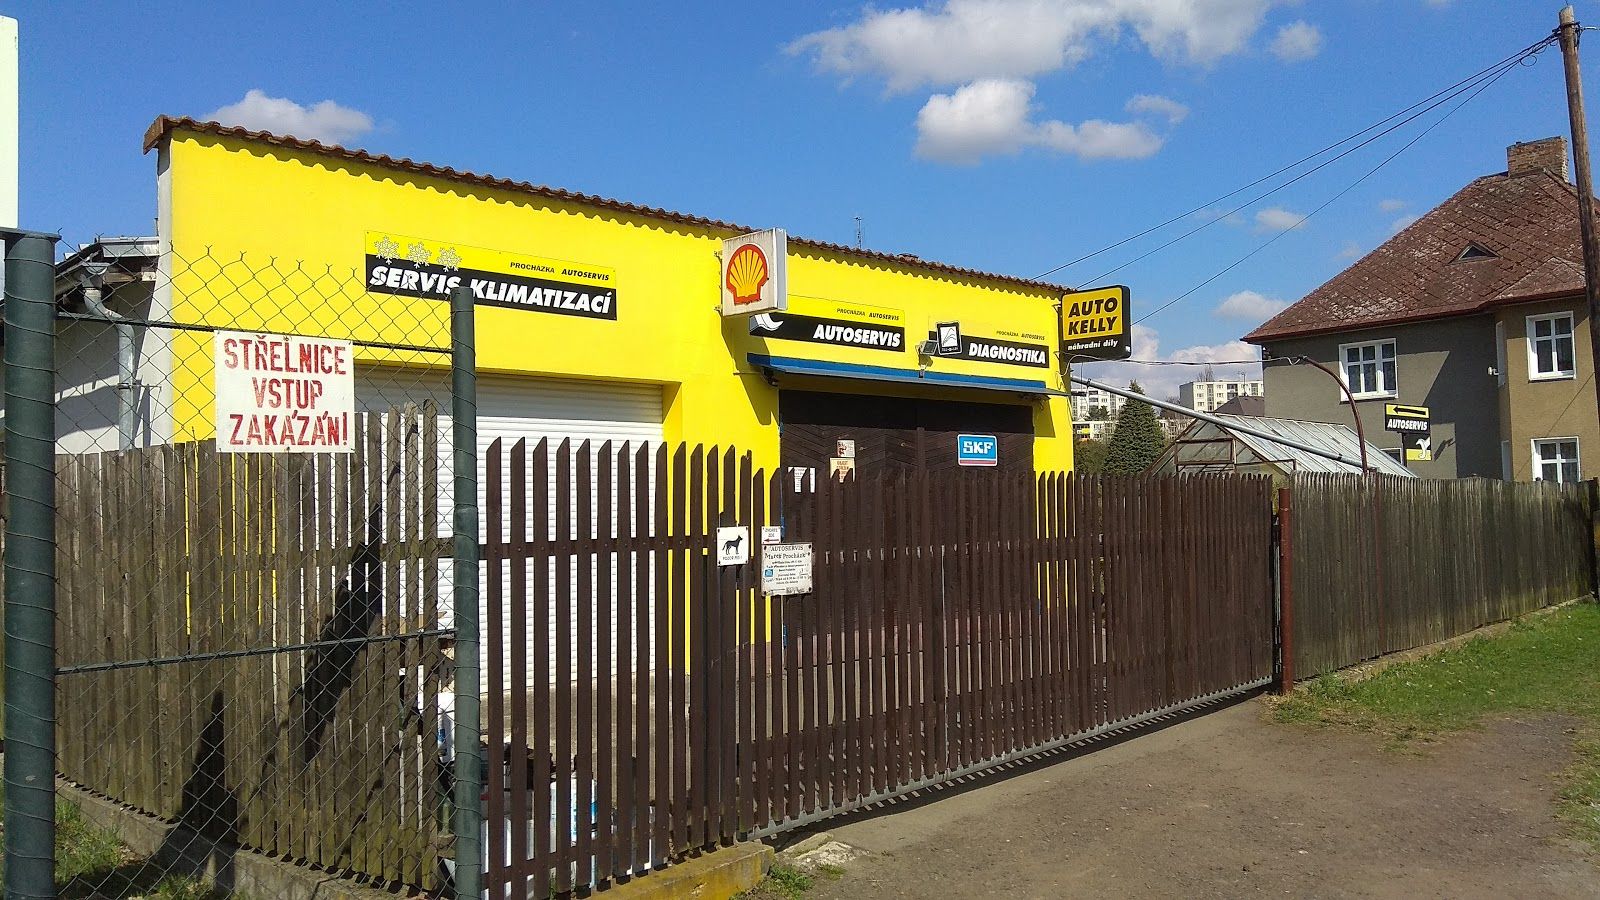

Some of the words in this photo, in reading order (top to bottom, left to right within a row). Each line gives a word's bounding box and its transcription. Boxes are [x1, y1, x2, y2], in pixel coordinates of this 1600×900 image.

[561, 268, 609, 281] AUTOSERVIS
[370, 265, 461, 295] SERVIS
[470, 278, 613, 314] KLIMATIZACÍ
[868, 312, 900, 321] AUTOSERVIS
[1068, 297, 1118, 318] AUTO
[813, 323, 901, 347] AUTOSERVIS
[1068, 316, 1118, 336] KELLY
[223, 334, 347, 375] STŘELNICE
[968, 342, 1046, 364] DIAGNOSTIKA
[252, 377, 323, 409] VSTUP
[229, 409, 348, 446] ZAKÁZÁN!
[1387, 418, 1428, 431] AUTOSERVIS
[962, 440, 993, 454] SKF
